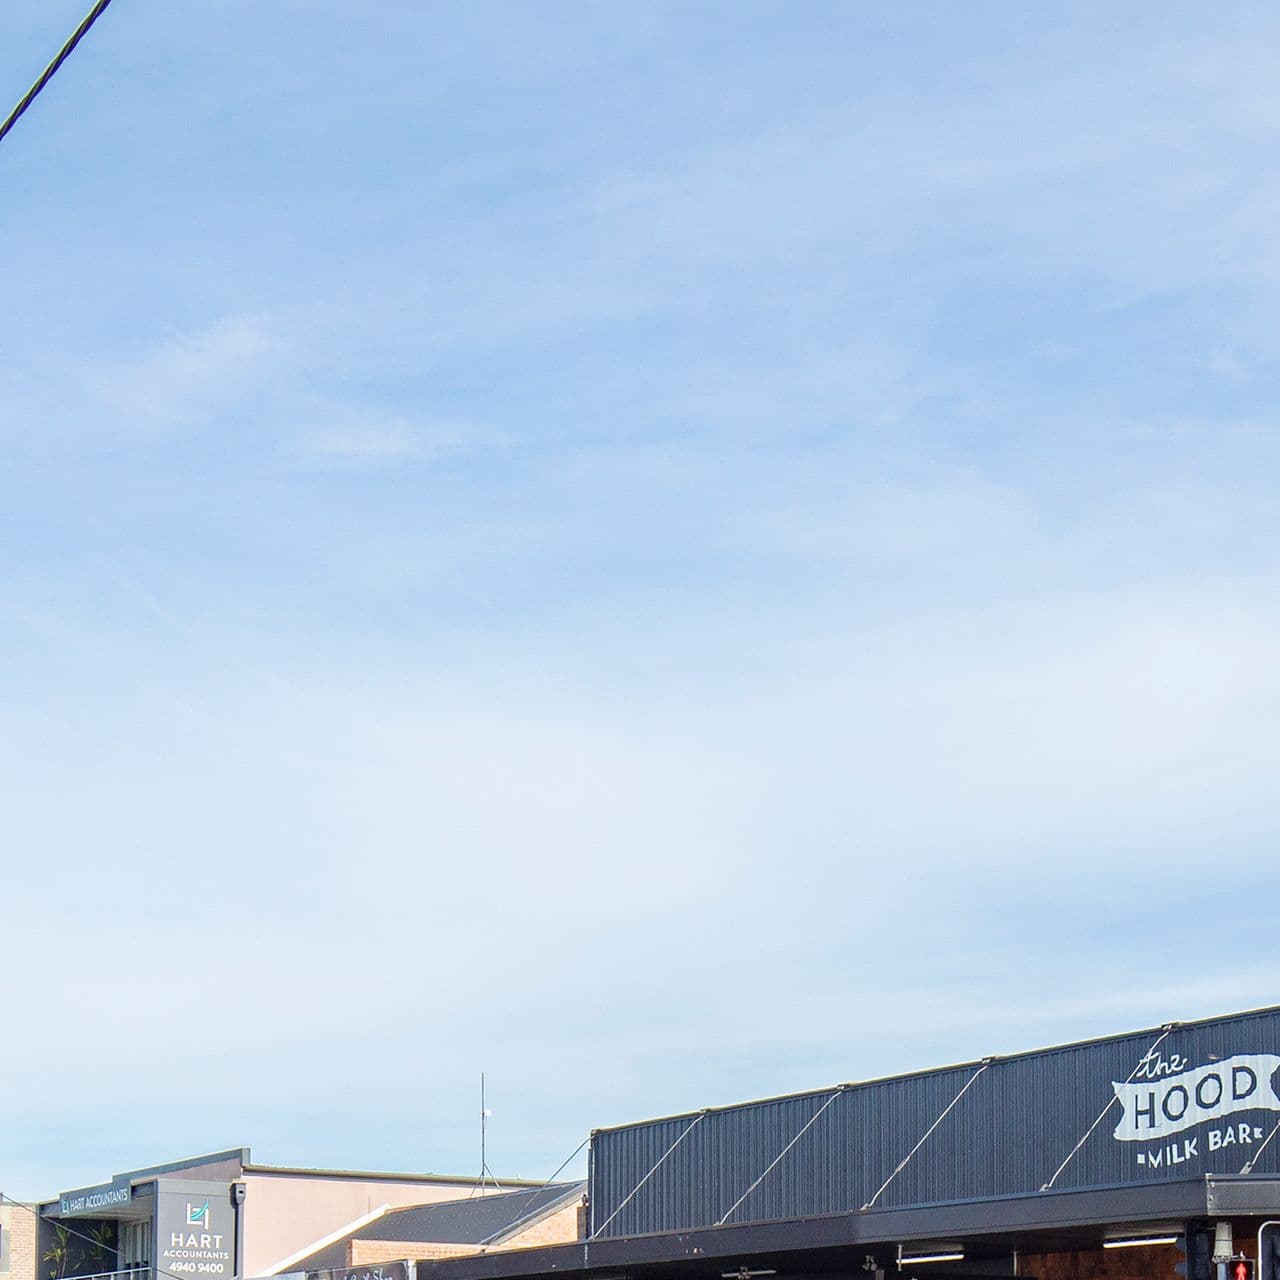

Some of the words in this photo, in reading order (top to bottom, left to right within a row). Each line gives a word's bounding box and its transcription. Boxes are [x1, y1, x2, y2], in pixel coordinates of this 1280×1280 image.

[1135, 1050, 1188, 1079] the
[1134, 1065, 1258, 1130] HOOD
[1147, 1136, 1199, 1169] MILK
[1207, 1122, 1252, 1151] BAR
[70, 1196, 85, 1211] HART
[85, 1187, 129, 1209] ACCOUNTANTS
[171, 1232, 223, 1249] HART
[163, 1249, 229, 1261] ACCOUNTANTS
[170, 1261, 196, 1273] 4940
[197, 1262, 224, 1273] 9400
